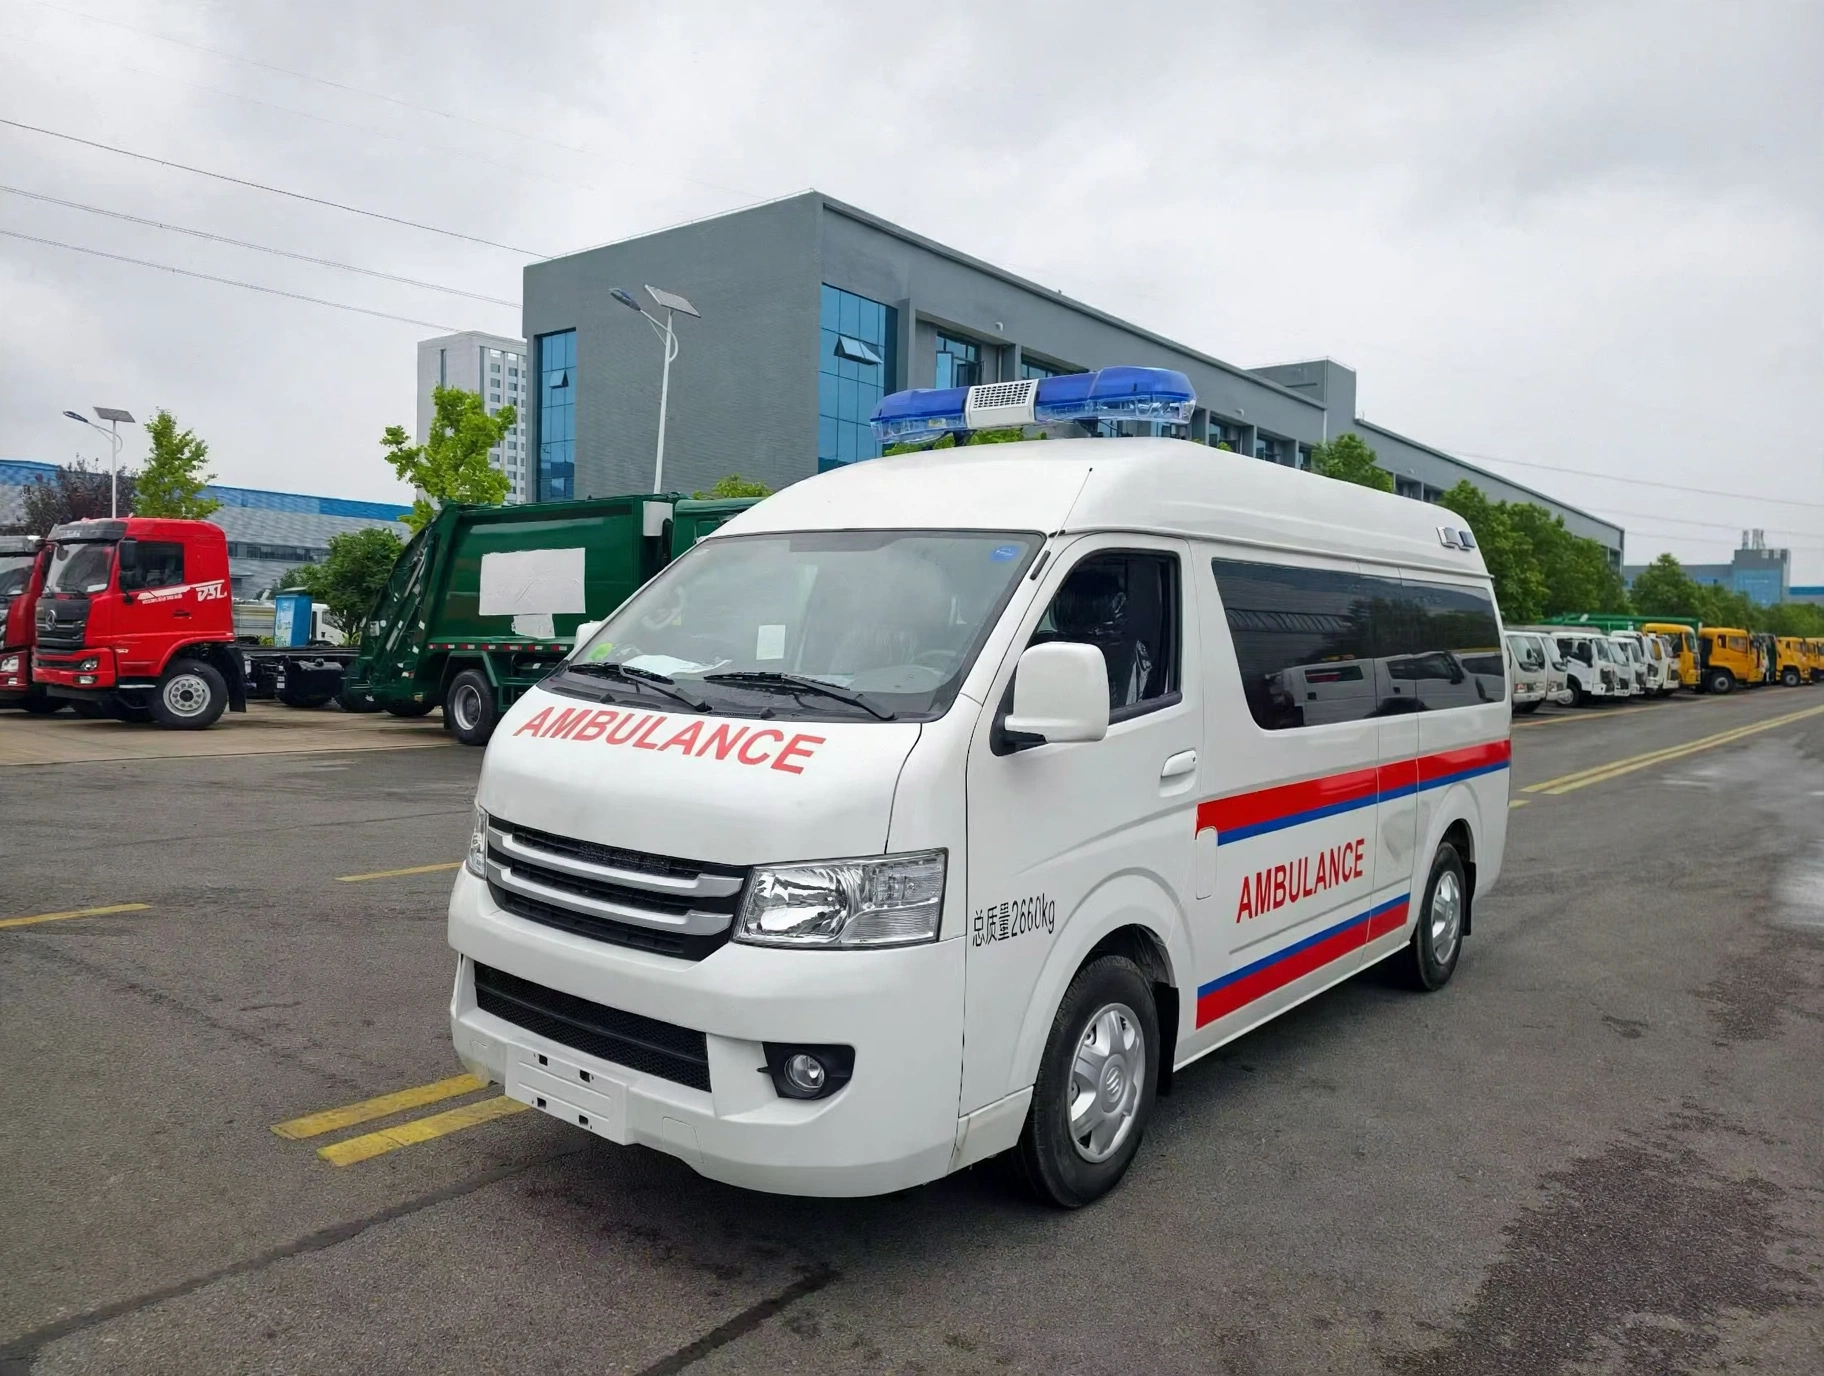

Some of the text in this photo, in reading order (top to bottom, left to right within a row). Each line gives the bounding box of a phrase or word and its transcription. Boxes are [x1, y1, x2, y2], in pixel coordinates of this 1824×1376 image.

[512, 706, 826, 774] AMBULANCE
[1236, 838, 1365, 924] AMBULANCE
[972, 892, 1056, 947] 总质量2660kg
